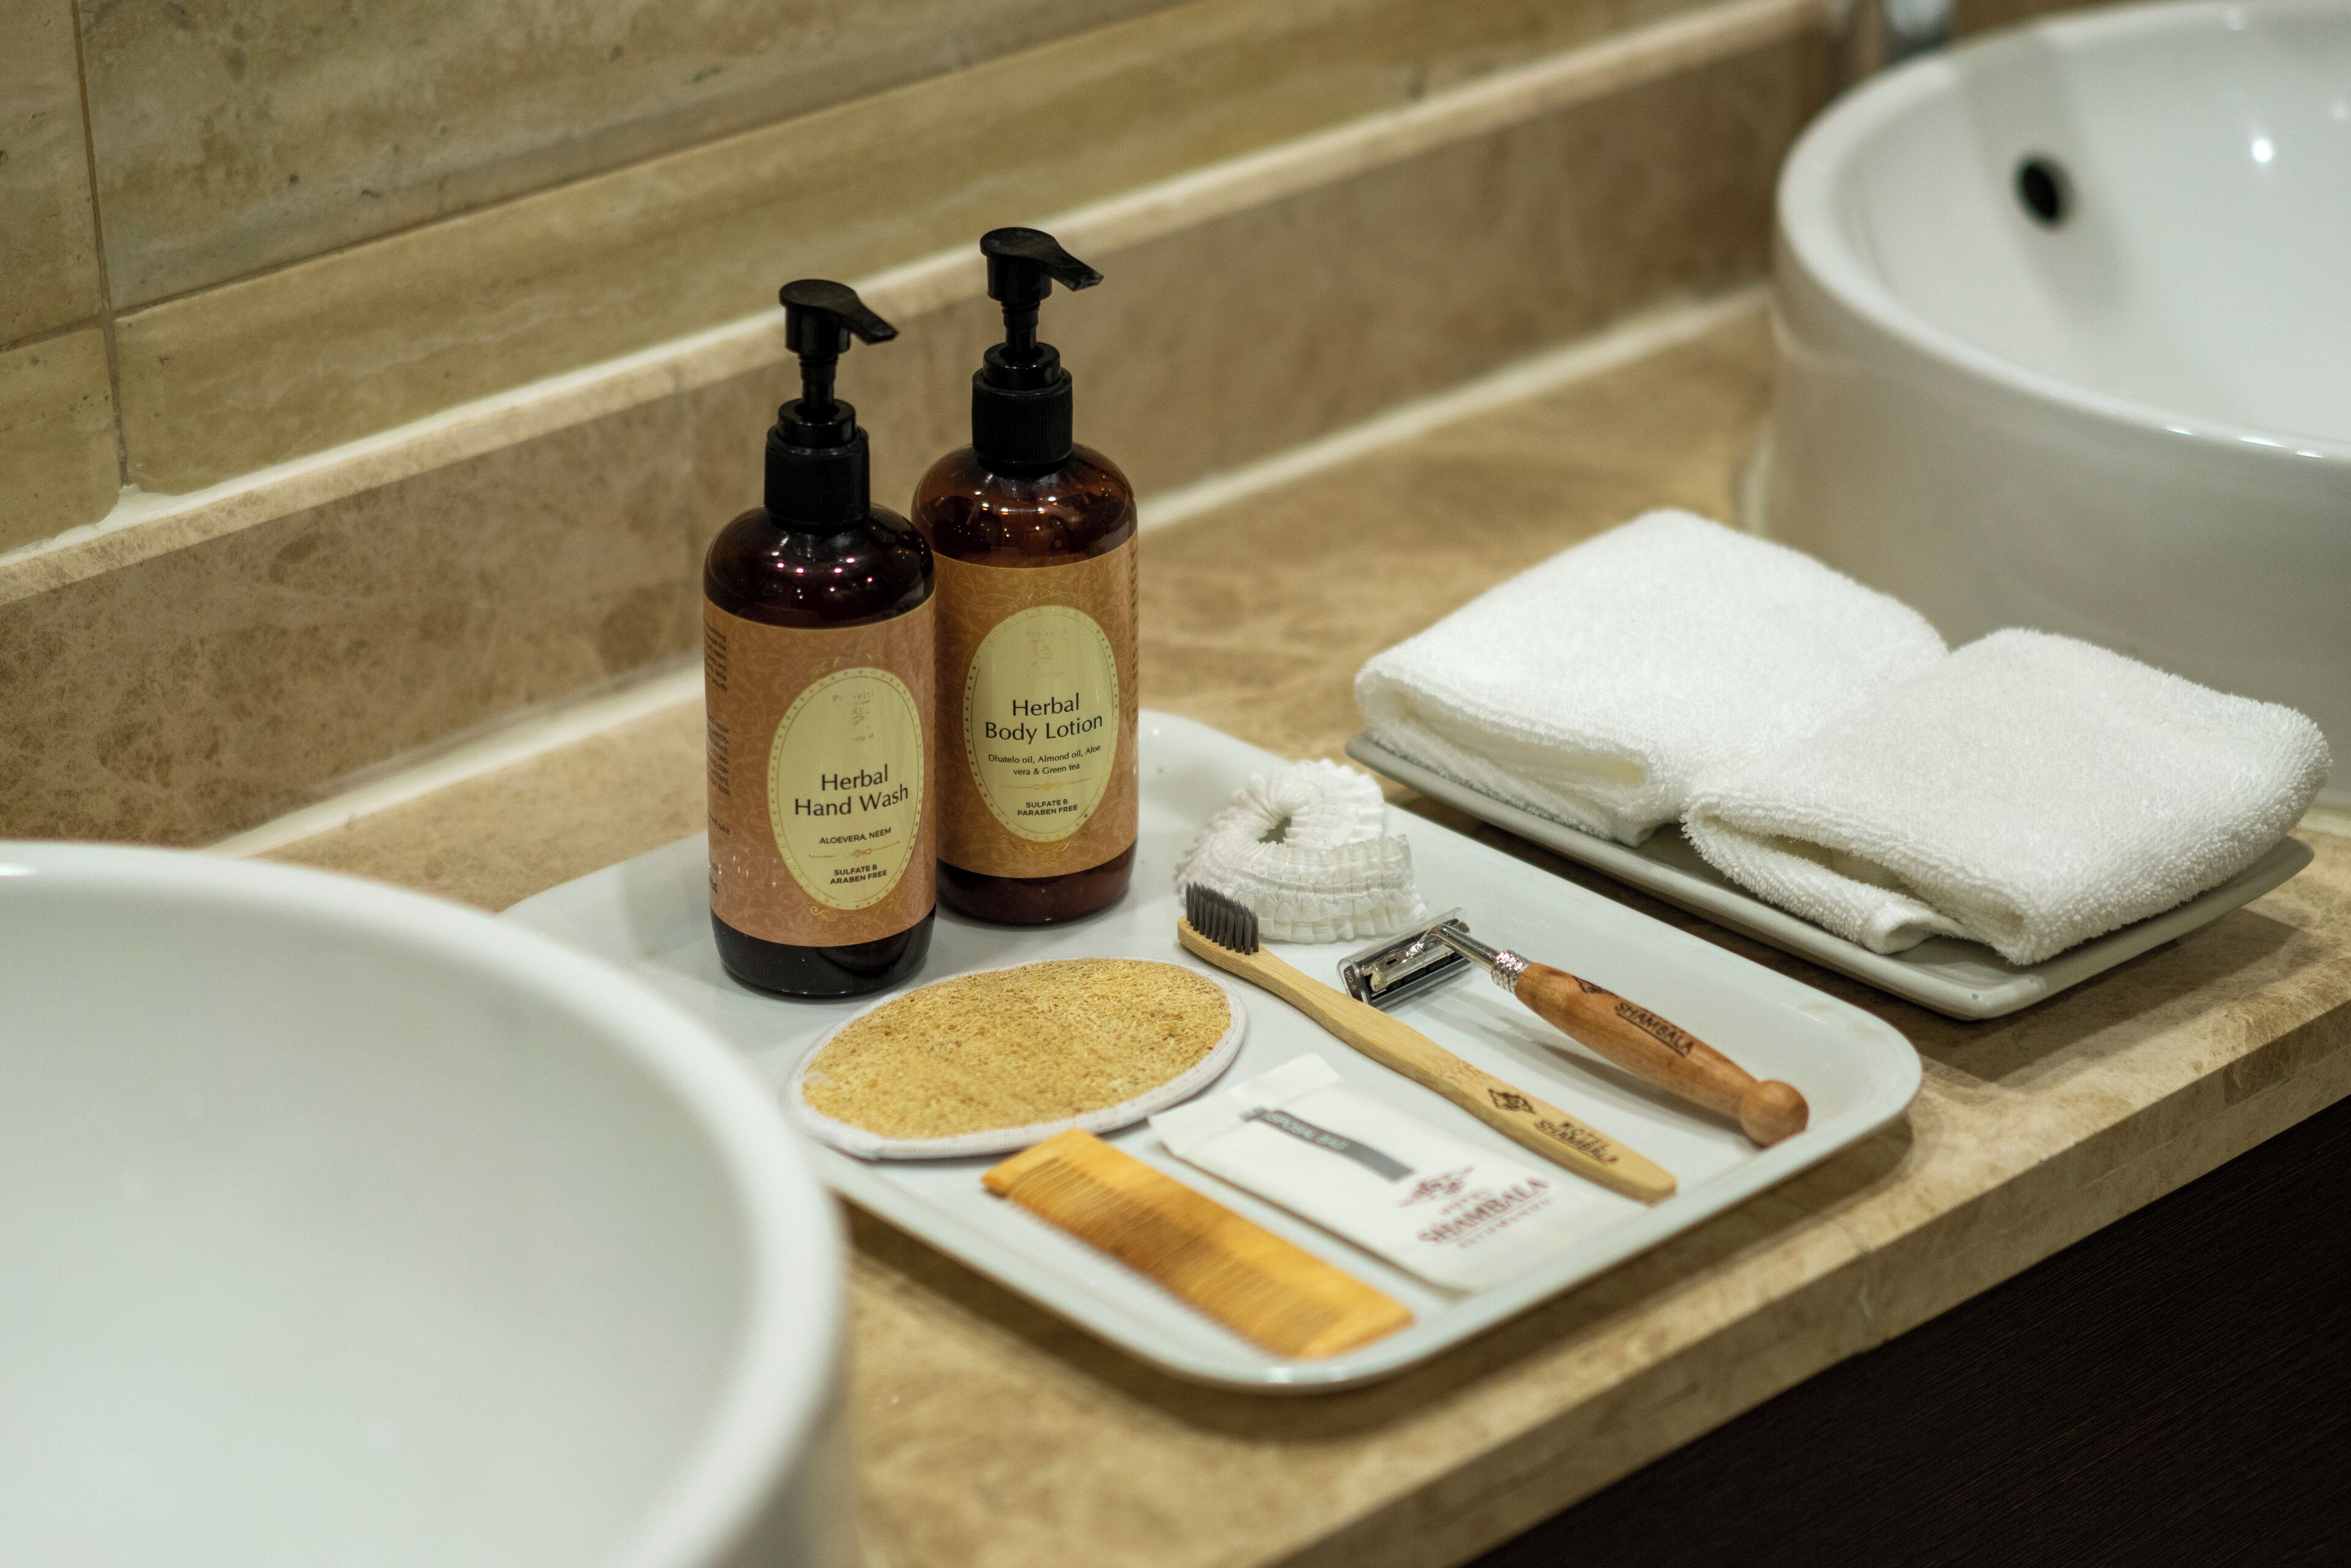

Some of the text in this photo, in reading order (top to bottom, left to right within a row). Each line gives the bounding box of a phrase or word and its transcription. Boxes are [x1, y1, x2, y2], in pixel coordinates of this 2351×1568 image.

[1013, 692, 1079, 716] Herbal
[986, 715, 1103, 745] Body Lotion
[988, 745, 1101, 765] Dhatelo oil, Almond oil, Aloe
[822, 764, 888, 791] Herbal
[1042, 765, 1067, 775] Green
[795, 783, 909, 816] Hand Wash
[1026, 800, 1061, 808] SULFATE
[1017, 805, 1078, 816] PARABEN FREE
[819, 827, 891, 844] ALOEVERA, NEEM
[834, 865, 871, 876] SULFATE
[868, 869, 887, 880] FREE
[1614, 1002, 1695, 1055] SHAMBALA
[1417, 1178, 1549, 1241] SHAMBALA
